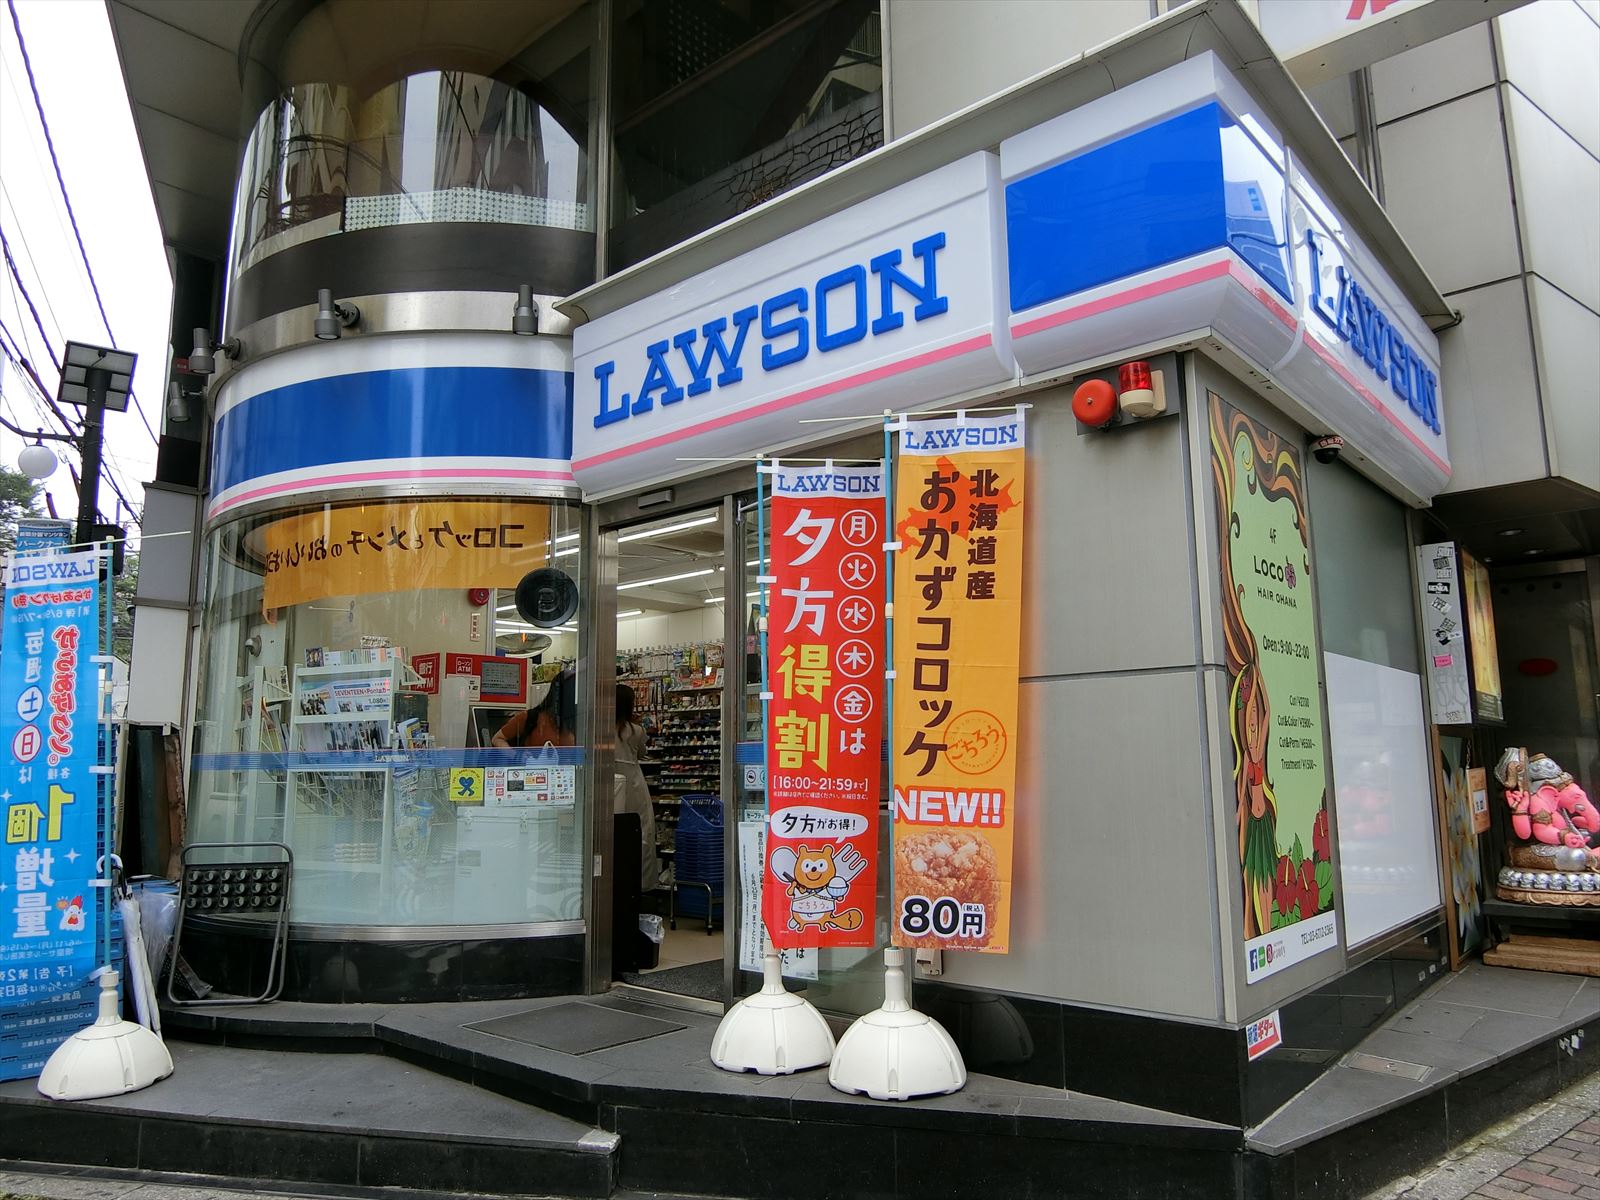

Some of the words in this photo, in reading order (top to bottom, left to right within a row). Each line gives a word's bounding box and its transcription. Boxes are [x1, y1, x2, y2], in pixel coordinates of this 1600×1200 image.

[594, 231, 949, 429] LAWSON
[1307, 228, 1441, 436] LAWSON
[905, 424, 1018, 450] LAWSON
[777, 474, 881, 493] LAWSON
[965, 468, 1000, 601] 北海道産
[1253, 554, 1285, 582] LOCO
[1257, 585, 1275, 602] HAIR
[1275, 593, 1297, 609] OHANA
[774, 508, 836, 773] 夕方得割
[903, 470, 960, 777] おかずコロッケ
[457, 665, 471, 673] ATM
[894, 788, 1001, 825] NEW!!
